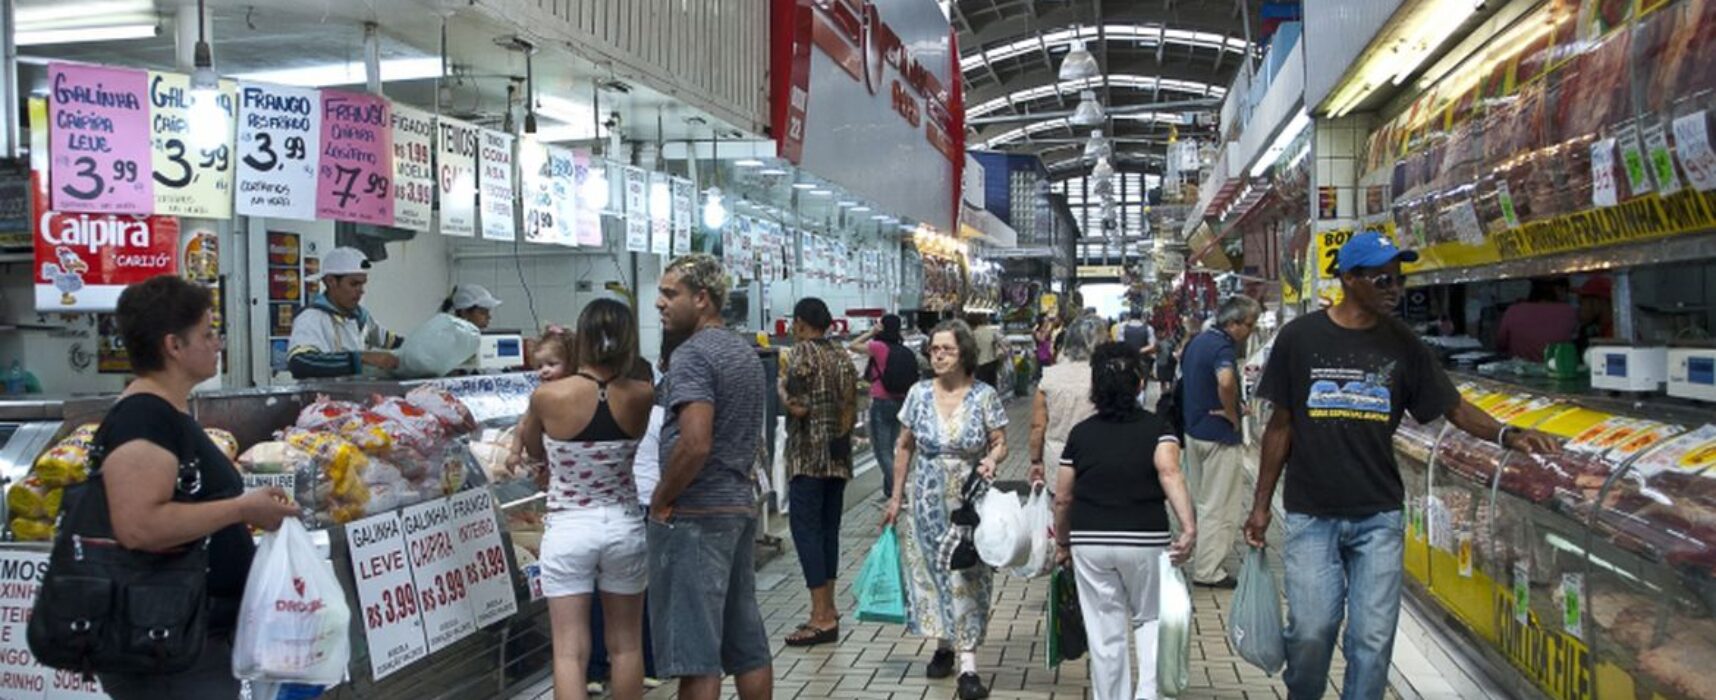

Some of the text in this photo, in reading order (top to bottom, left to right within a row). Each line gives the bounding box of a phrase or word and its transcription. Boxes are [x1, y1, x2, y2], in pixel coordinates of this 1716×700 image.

[243, 87, 311, 116] FRANGO
[324, 98, 387, 127] FRANGO
[68, 133, 112, 153] LEVE
[243, 132, 306, 171] 3,99
[62, 156, 138, 200] 3,99
[332, 163, 390, 208] 7,99
[40, 211, 149, 254] Caipira
[405, 505, 449, 535] GALINHA
[452, 493, 491, 519] FRANGO
[352, 519, 399, 548] GALINHA
[359, 550, 404, 580] LEVE
[434, 567, 467, 606] 3,99
[382, 583, 417, 625] 3,99
